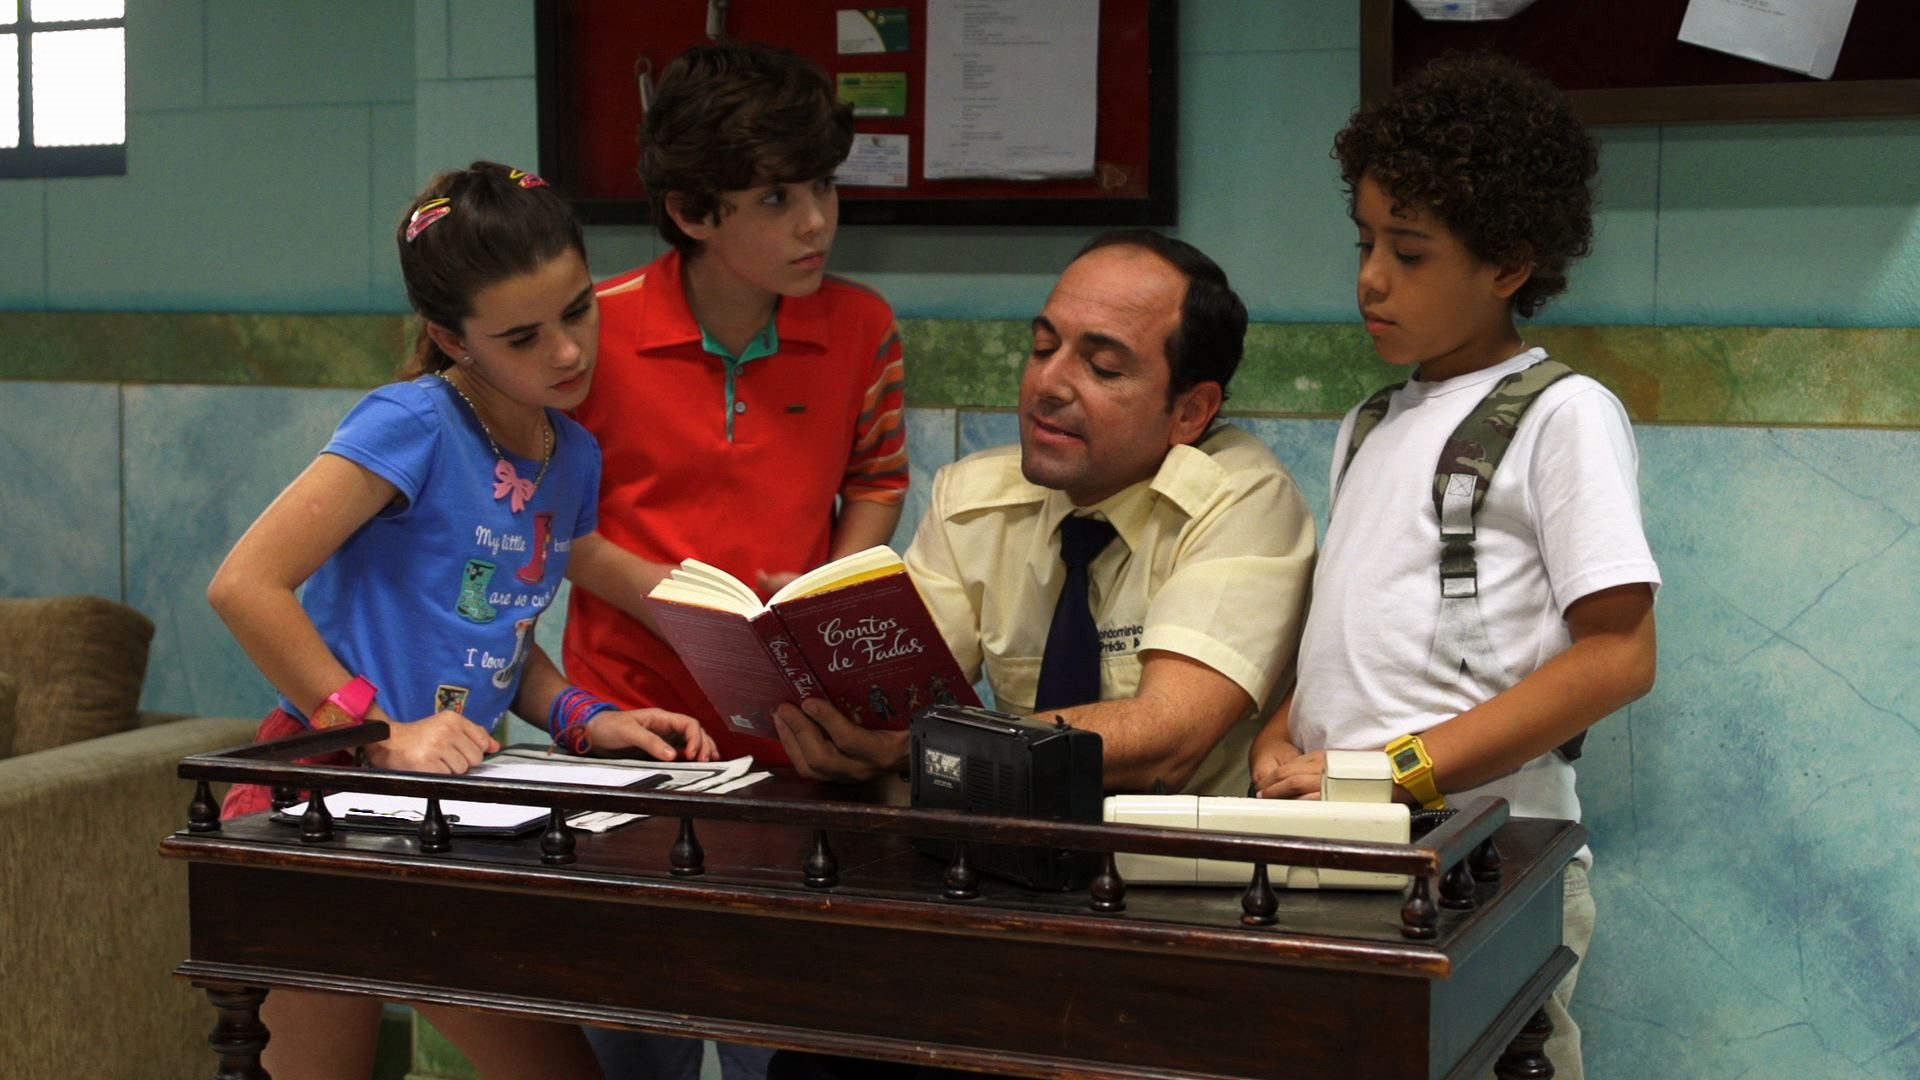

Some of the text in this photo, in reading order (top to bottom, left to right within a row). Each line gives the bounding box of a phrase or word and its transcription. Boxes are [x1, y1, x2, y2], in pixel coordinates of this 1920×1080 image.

[475, 525, 500, 556] My
[501, 534, 526, 552] little
[489, 592, 512, 605] are
[514, 594, 529, 607] so
[817, 615, 897, 647] Contos
[463, 648, 478, 667] I
[481, 651, 507, 668] love
[769, 640, 789, 667] Contos
[784, 667, 801, 679] de
[828, 627, 926, 672] de Fadas
